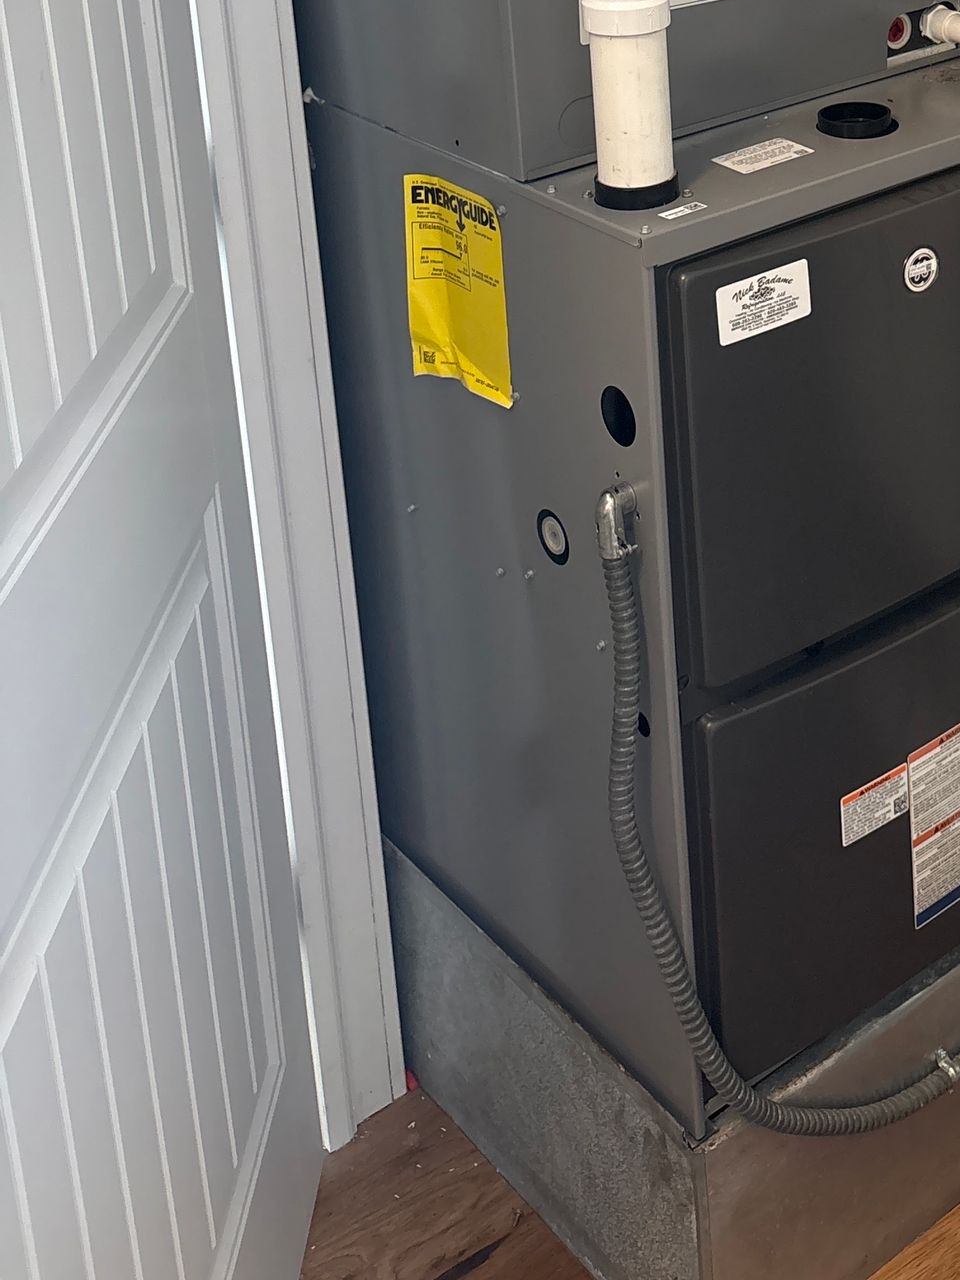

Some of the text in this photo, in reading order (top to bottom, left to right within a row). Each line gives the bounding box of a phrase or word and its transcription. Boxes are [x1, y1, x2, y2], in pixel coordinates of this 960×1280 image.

[732, 275, 794, 303] Nick Badame
[865, 775, 891, 792] WARNING
